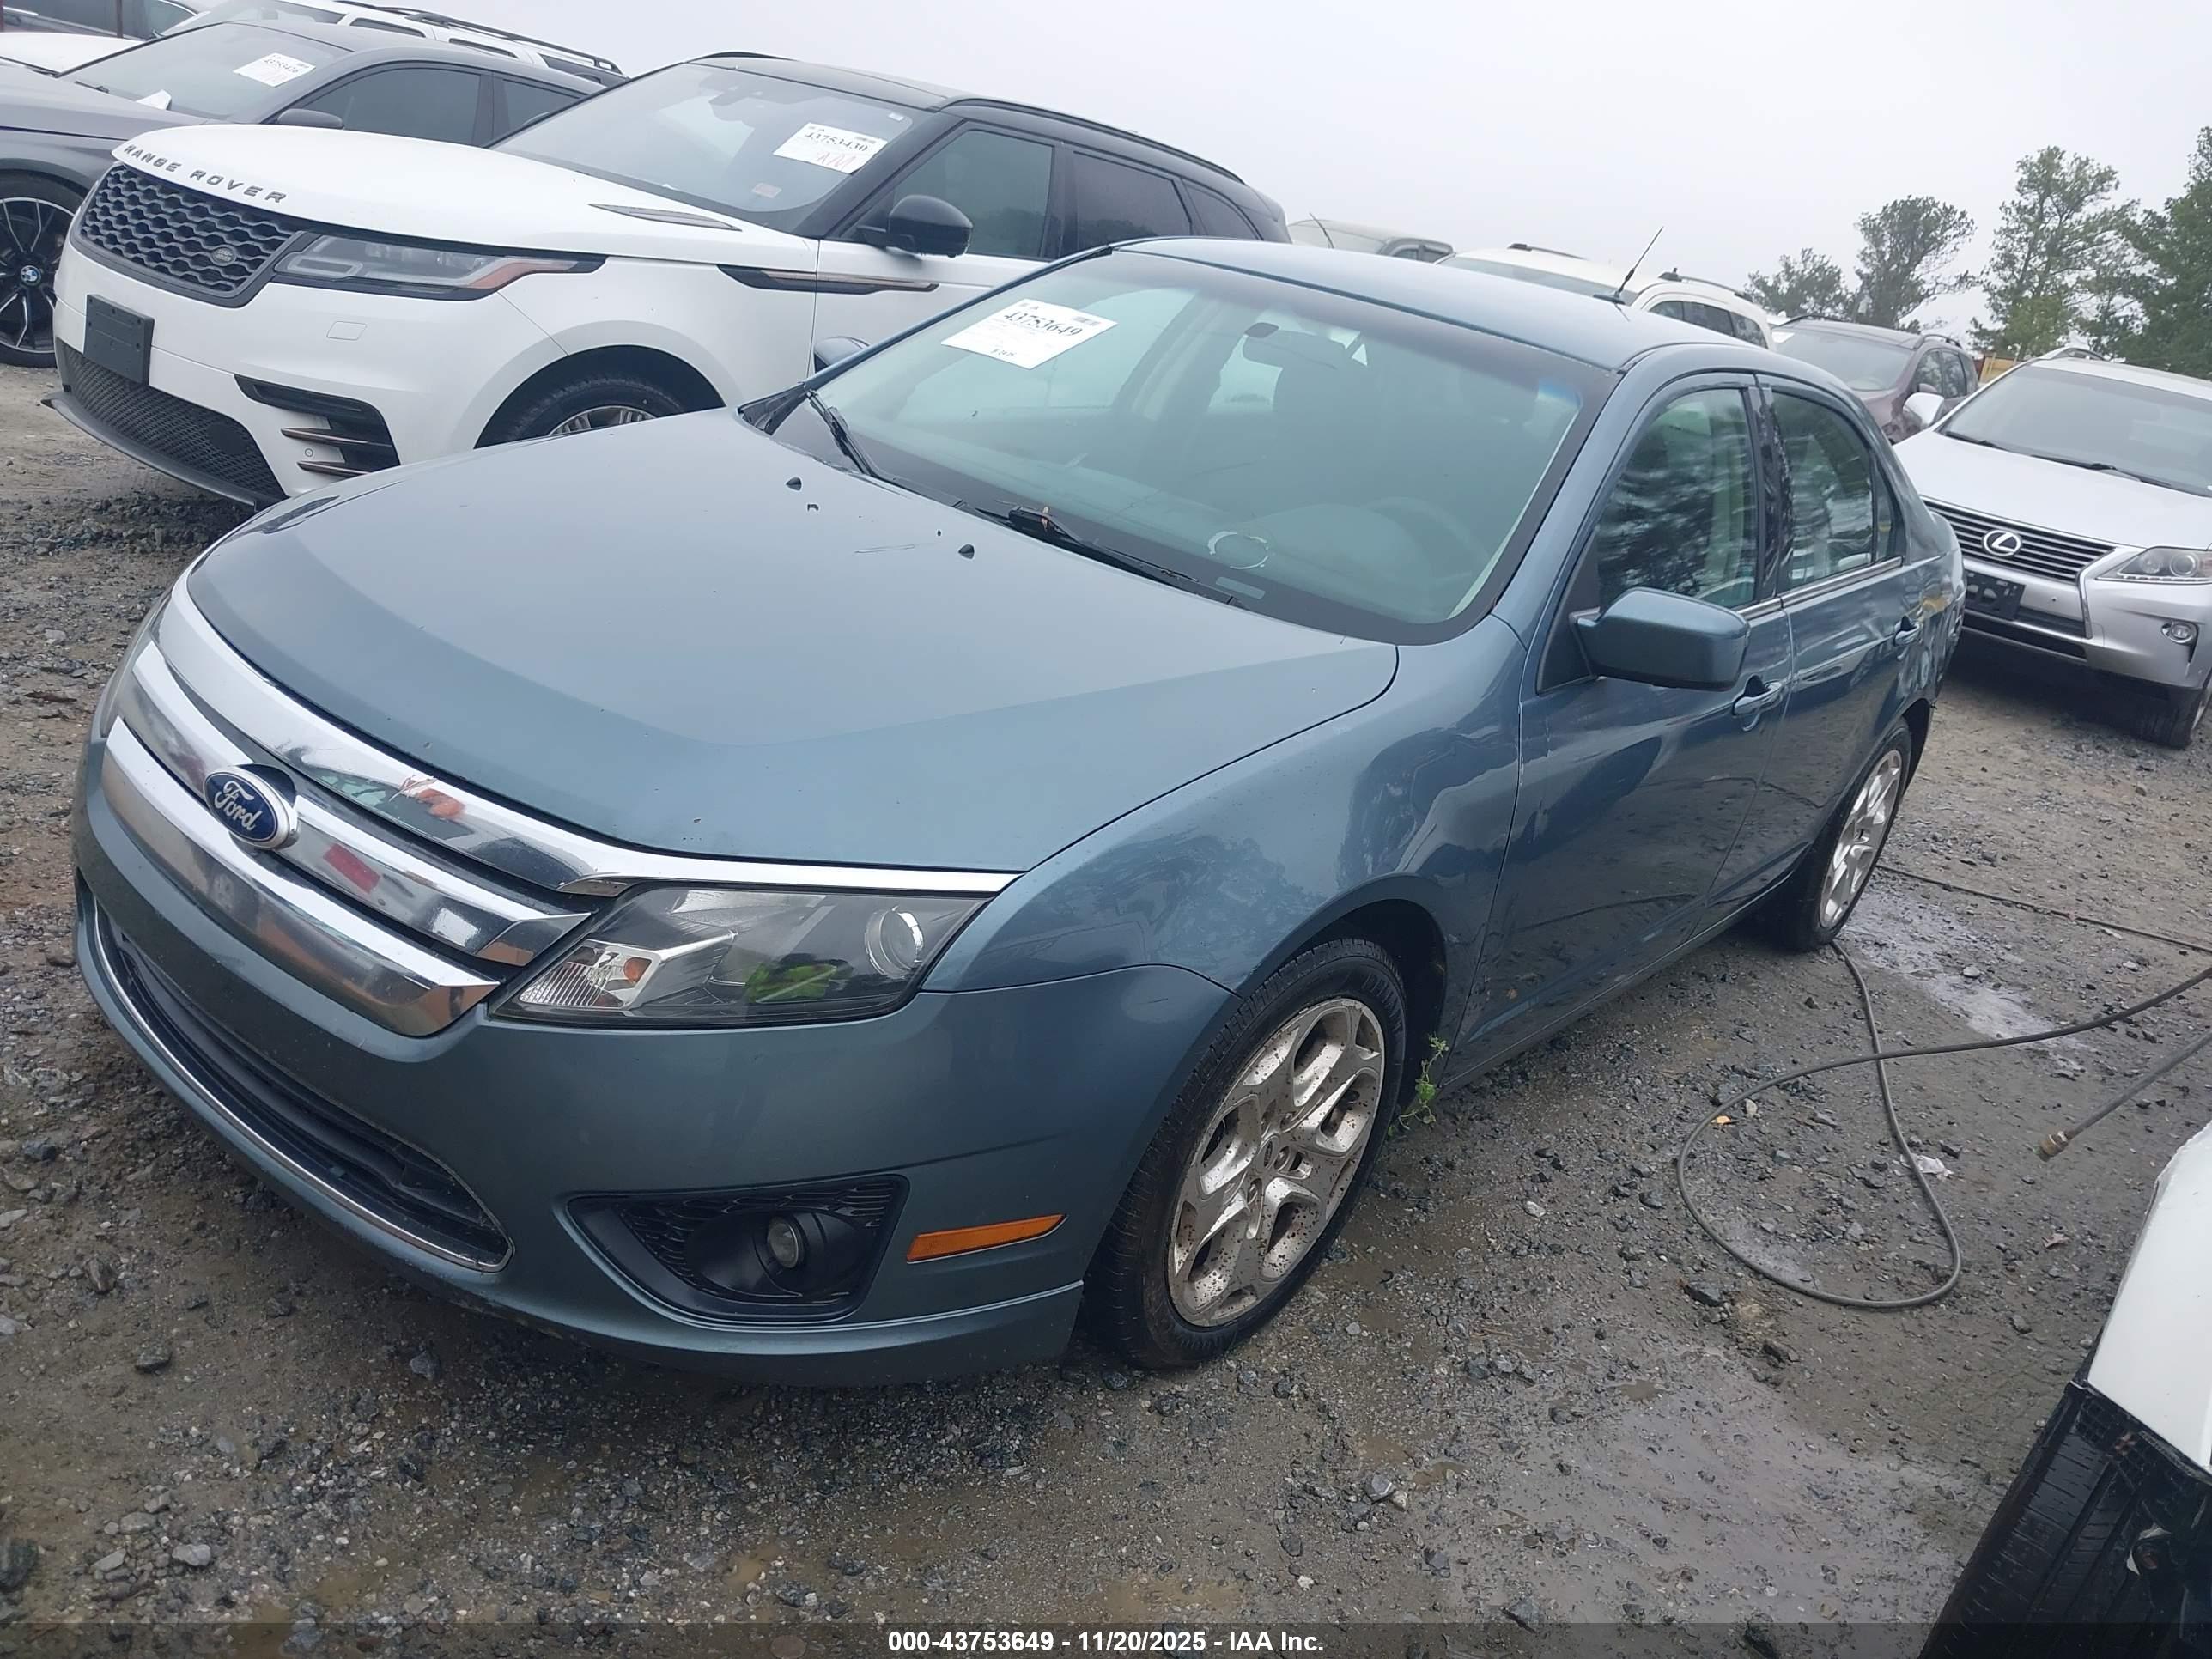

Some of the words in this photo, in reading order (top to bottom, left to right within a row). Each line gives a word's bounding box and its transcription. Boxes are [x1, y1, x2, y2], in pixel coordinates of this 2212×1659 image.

[124, 144, 182, 173] RANGE
[189, 169, 287, 204] ROVER
[1003, 311, 1083, 337] 43753649
[214, 780, 263, 831] Ford
